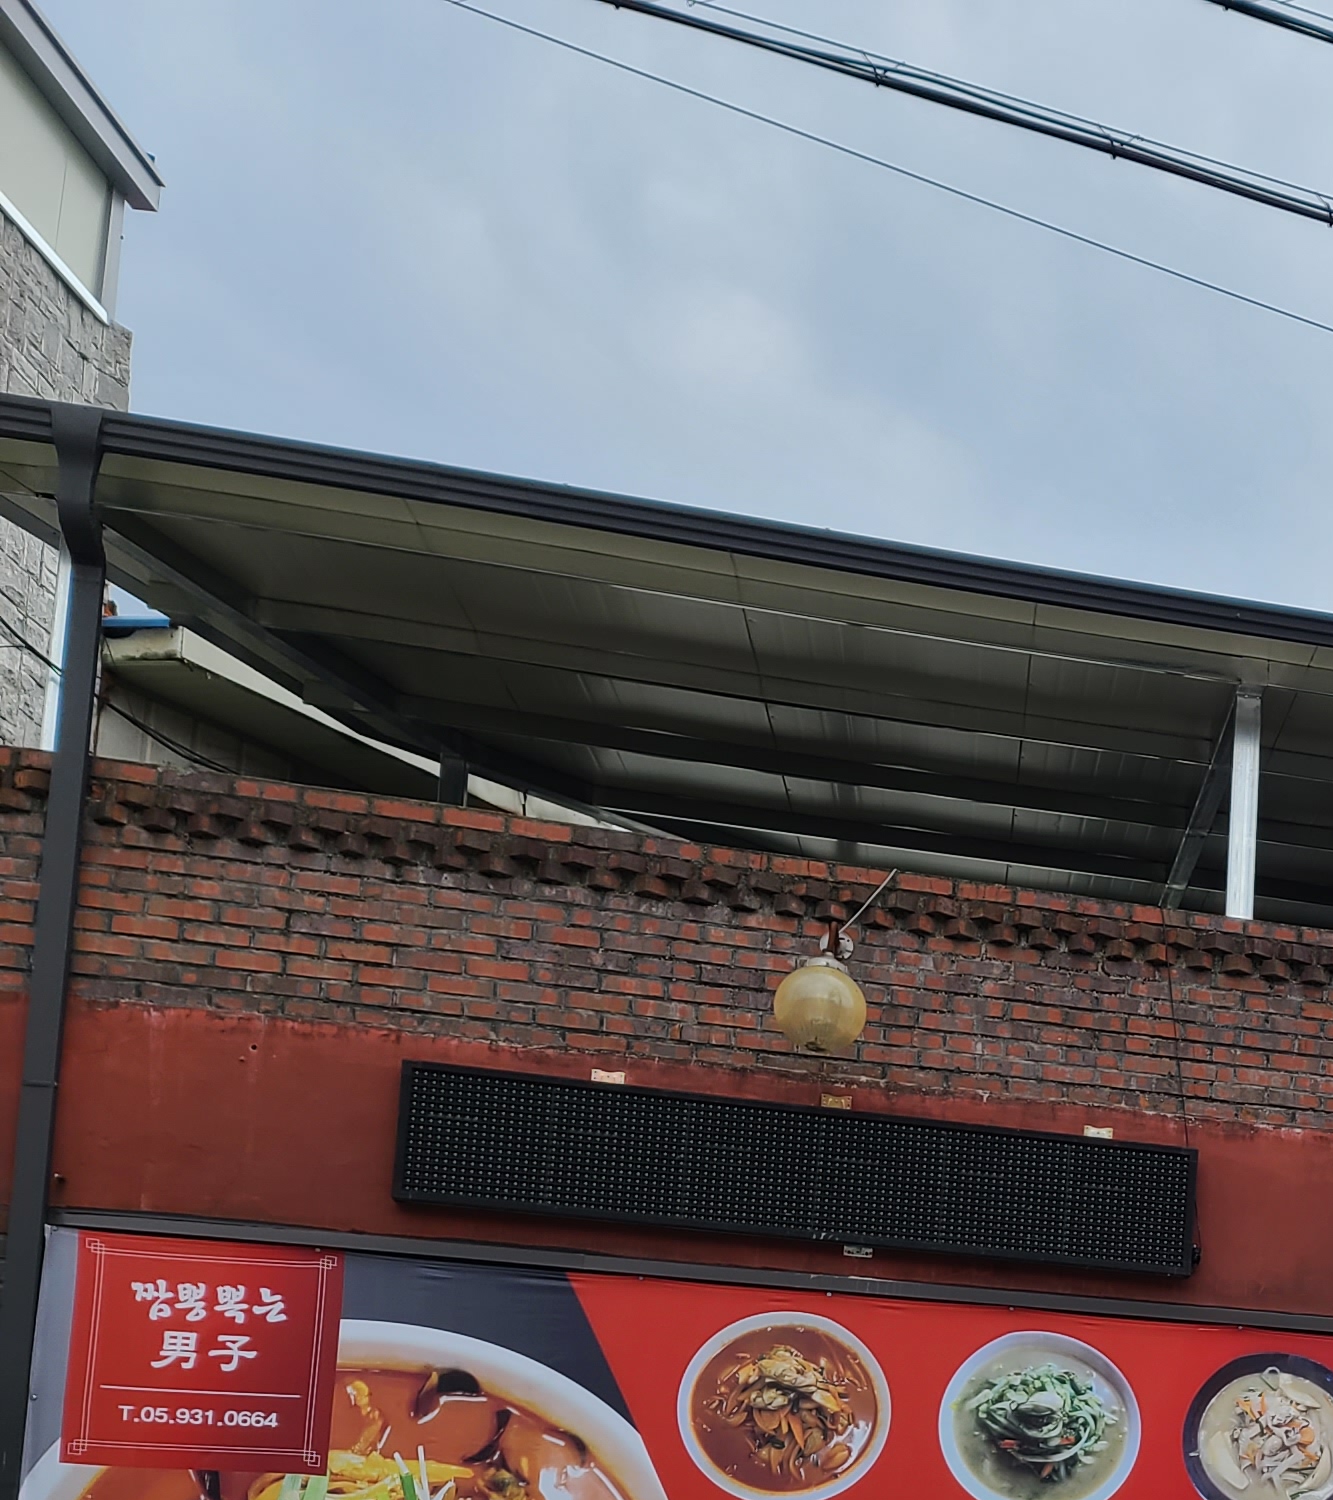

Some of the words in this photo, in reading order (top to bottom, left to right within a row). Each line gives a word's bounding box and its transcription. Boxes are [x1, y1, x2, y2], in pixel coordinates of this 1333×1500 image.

[131, 1279, 288, 1324] 짬뽕뽁는
[150, 1330, 258, 1372] 男子
[118, 1405, 278, 1428] T.05.931.0664
